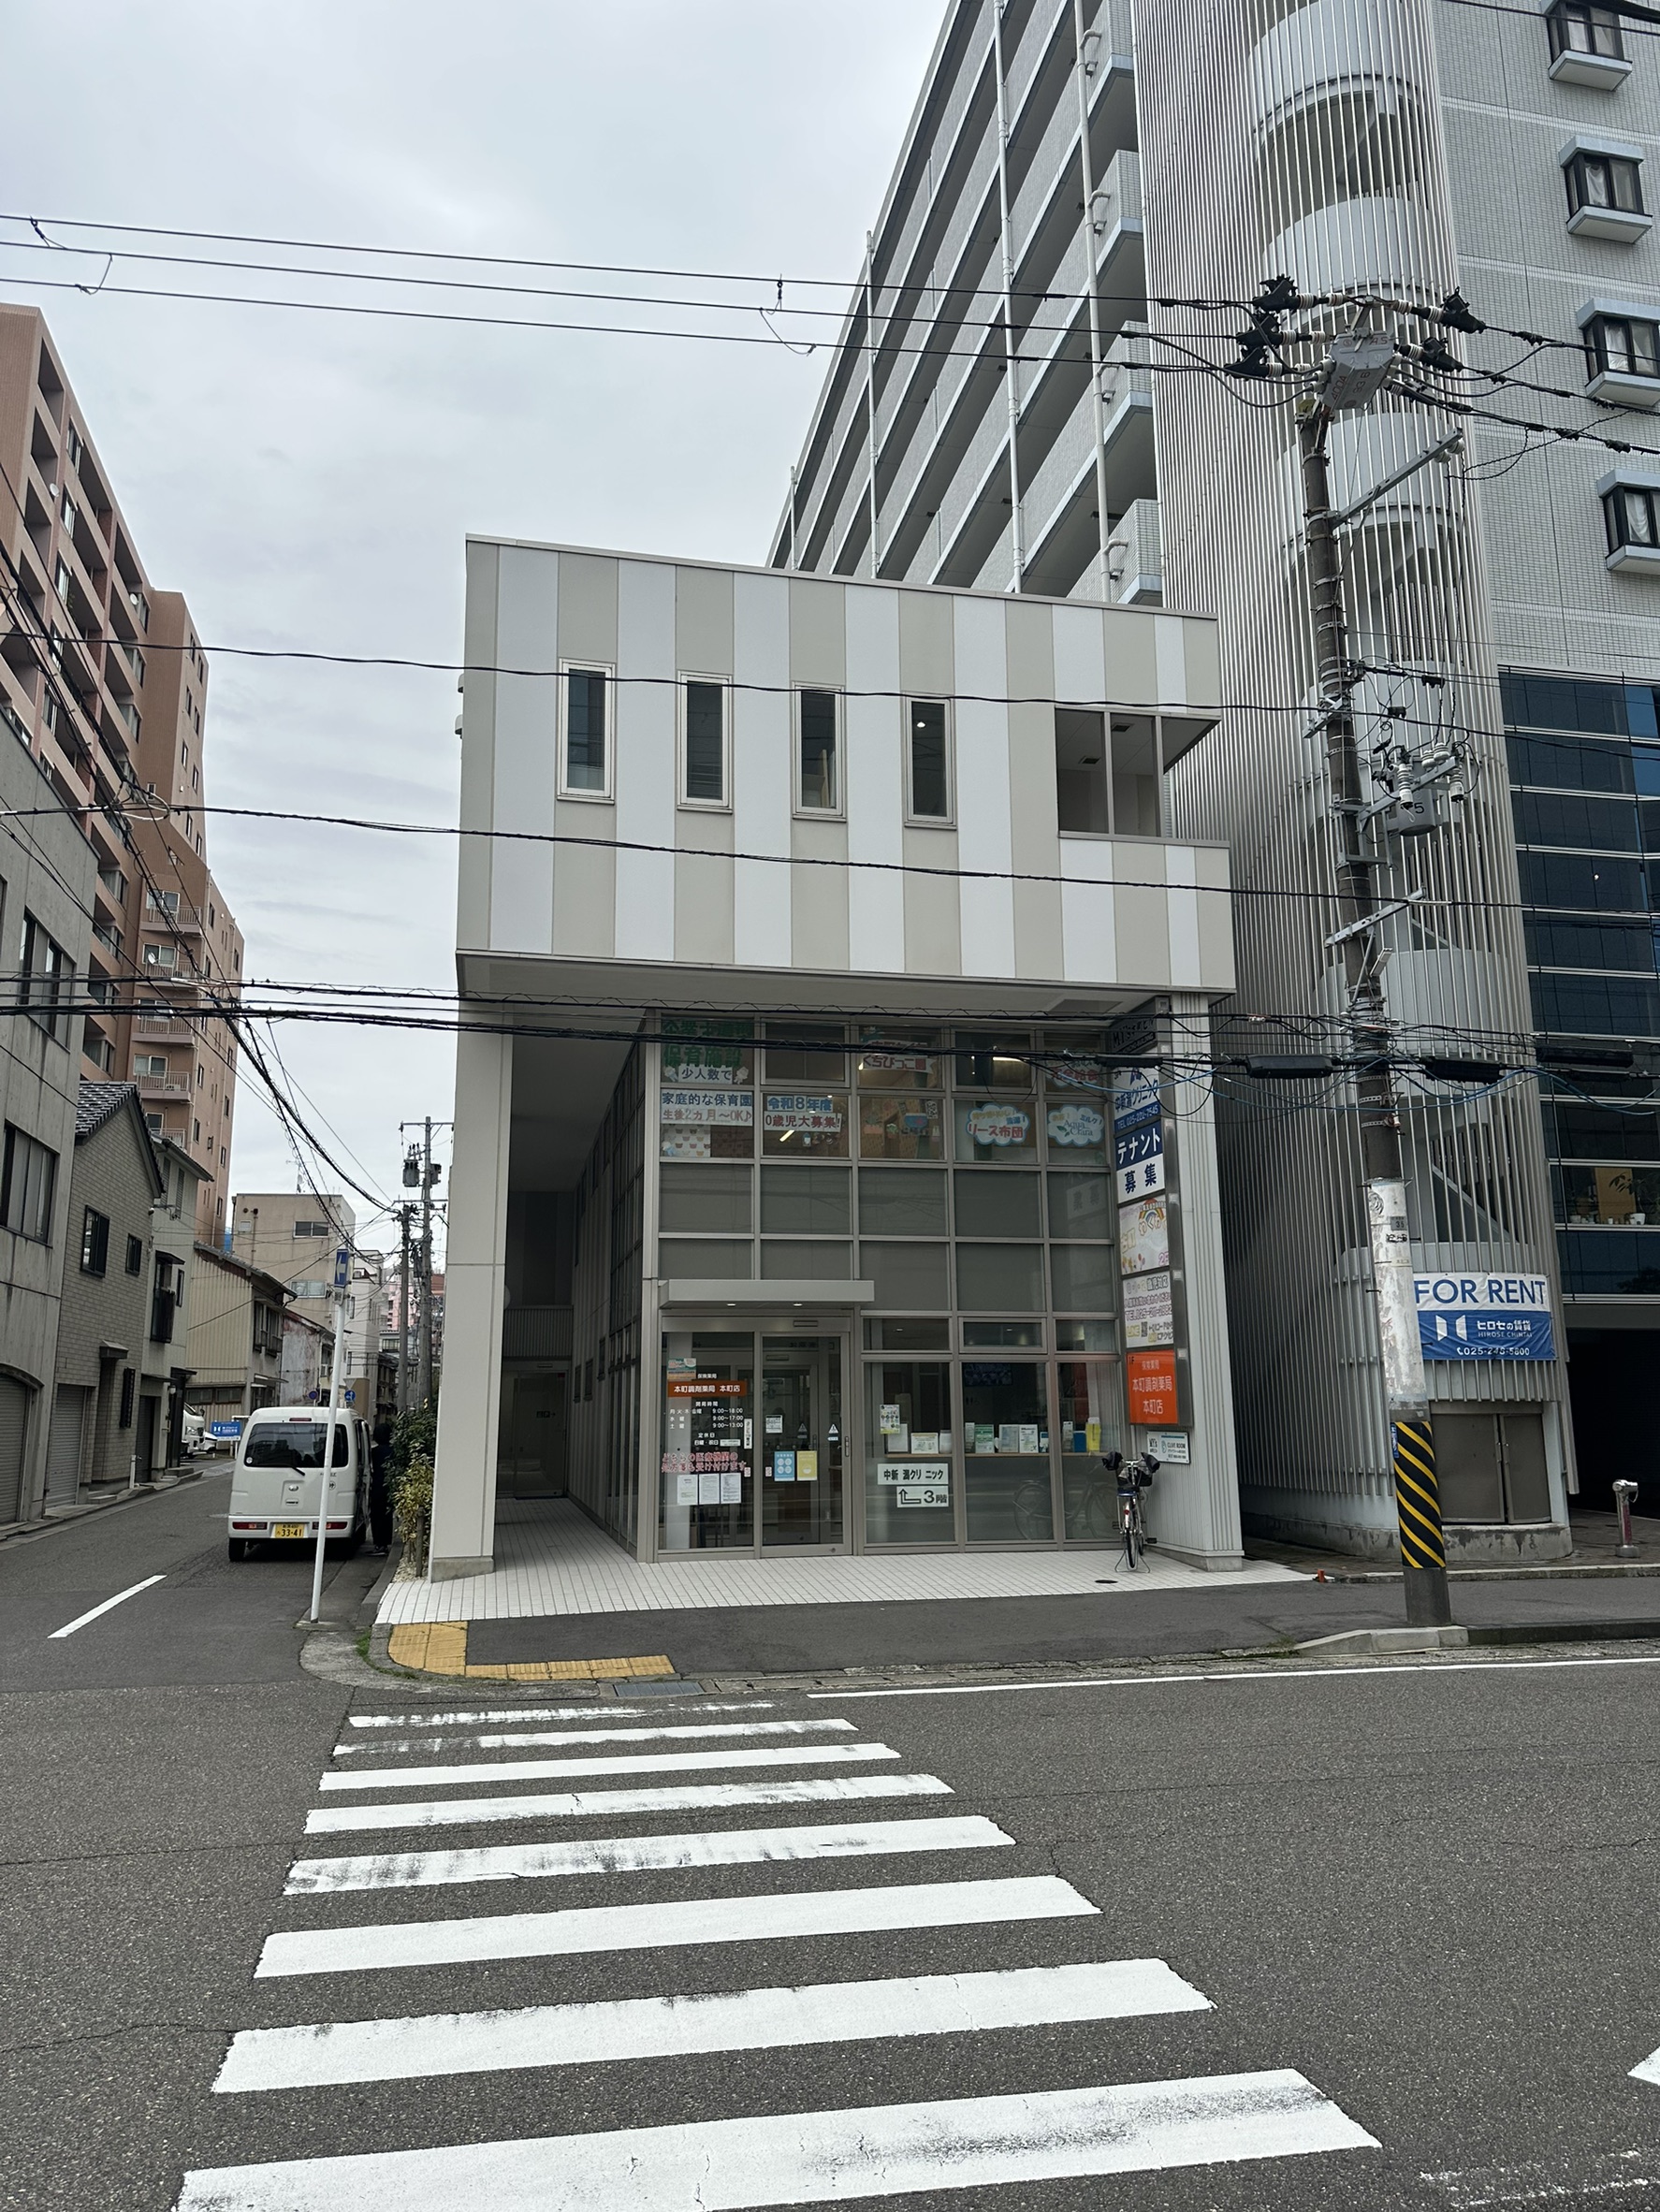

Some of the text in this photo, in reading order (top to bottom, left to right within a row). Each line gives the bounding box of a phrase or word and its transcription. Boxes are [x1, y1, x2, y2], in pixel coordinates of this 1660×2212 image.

[681, 1068, 732, 1081] 少人数で
[662, 1091, 753, 1107] 家庭的な保育園
[767, 1097, 833, 1113] 令和8年度
[968, 1123, 1024, 1139] リース布団
[1117, 1128, 1161, 1165] テナント
[1125, 1163, 1158, 1195] 募集
[1414, 1279, 1546, 1304] FOR RENT
[1477, 1319, 1532, 1332] ヒロセの賃貸
[674, 1385, 716, 1393] 本町調剤薬局
[1143, 1399, 1164, 1415] 本町店
[923, 1490, 948, 1505] 3階
